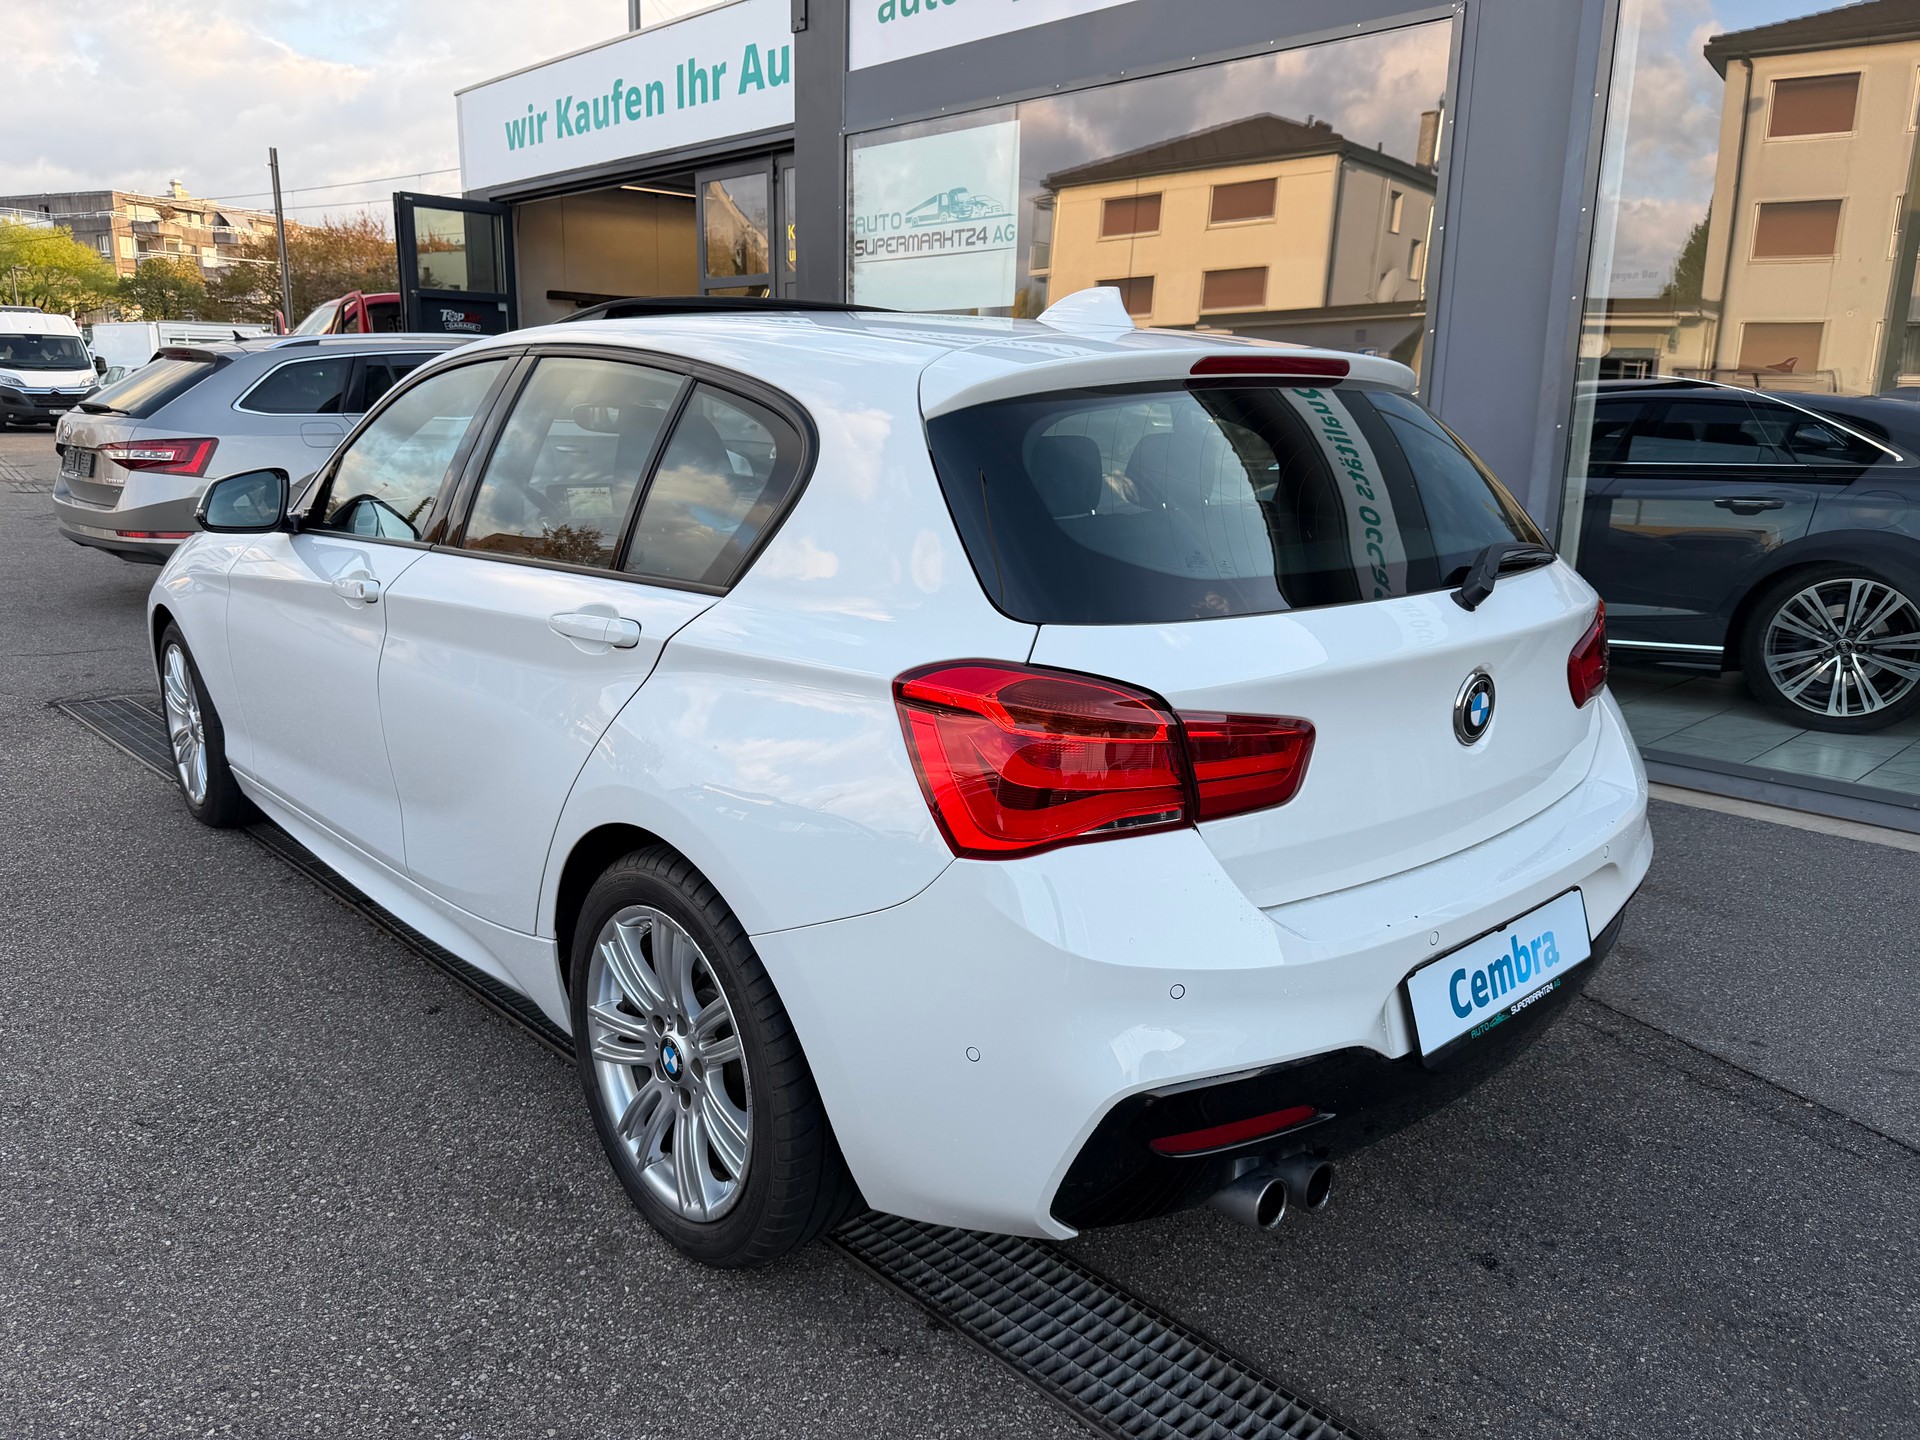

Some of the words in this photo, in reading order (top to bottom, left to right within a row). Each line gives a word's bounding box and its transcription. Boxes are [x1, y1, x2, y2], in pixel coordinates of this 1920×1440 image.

[504, 103, 548, 151] wir
[555, 78, 665, 139] Kaufen
[676, 58, 727, 110] Ihr
[737, 43, 790, 95] Au
[855, 212, 902, 234] AUTO
[855, 226, 988, 257] SUPERMARKT24
[992, 224, 1015, 243] AG
[1449, 931, 1560, 1019] Cembra
[1471, 1022, 1490, 1039] AUTO
